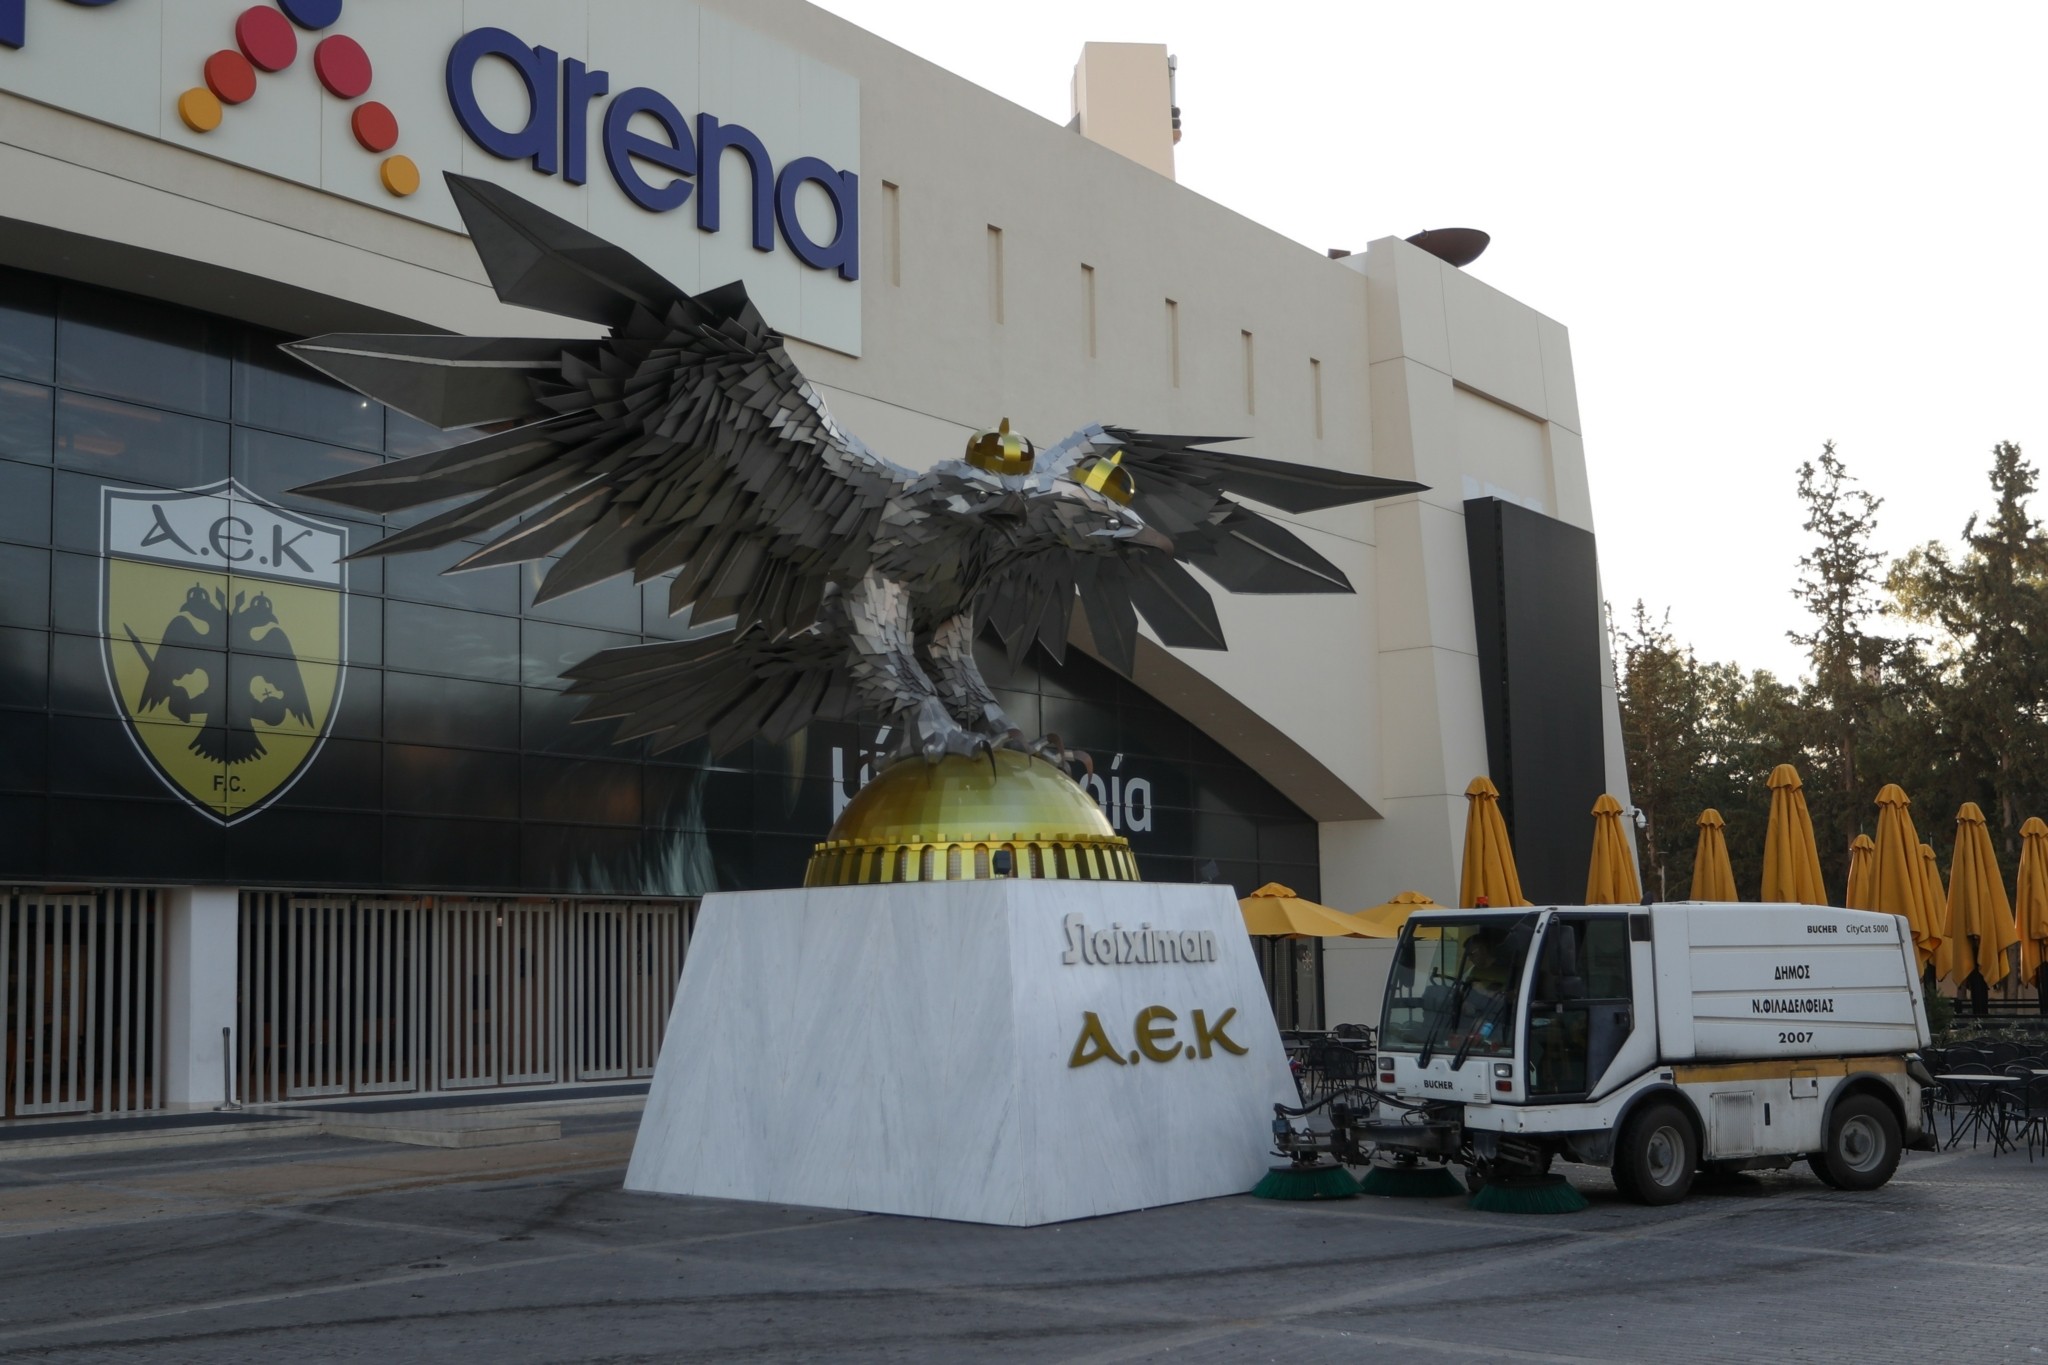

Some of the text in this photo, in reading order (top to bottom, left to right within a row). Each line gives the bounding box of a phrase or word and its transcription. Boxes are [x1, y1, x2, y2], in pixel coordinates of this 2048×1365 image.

[446, 27, 859, 281] arena
[1807, 924, 1889, 935] BUCHER CityCat 5000
[1062, 912, 1218, 966] Stoiximan
[1774, 965, 1811, 980] ΔΗΜΟΣ
[1778, 1032, 1814, 1044] 2007
[1423, 1079, 1454, 1090] BUCHER
